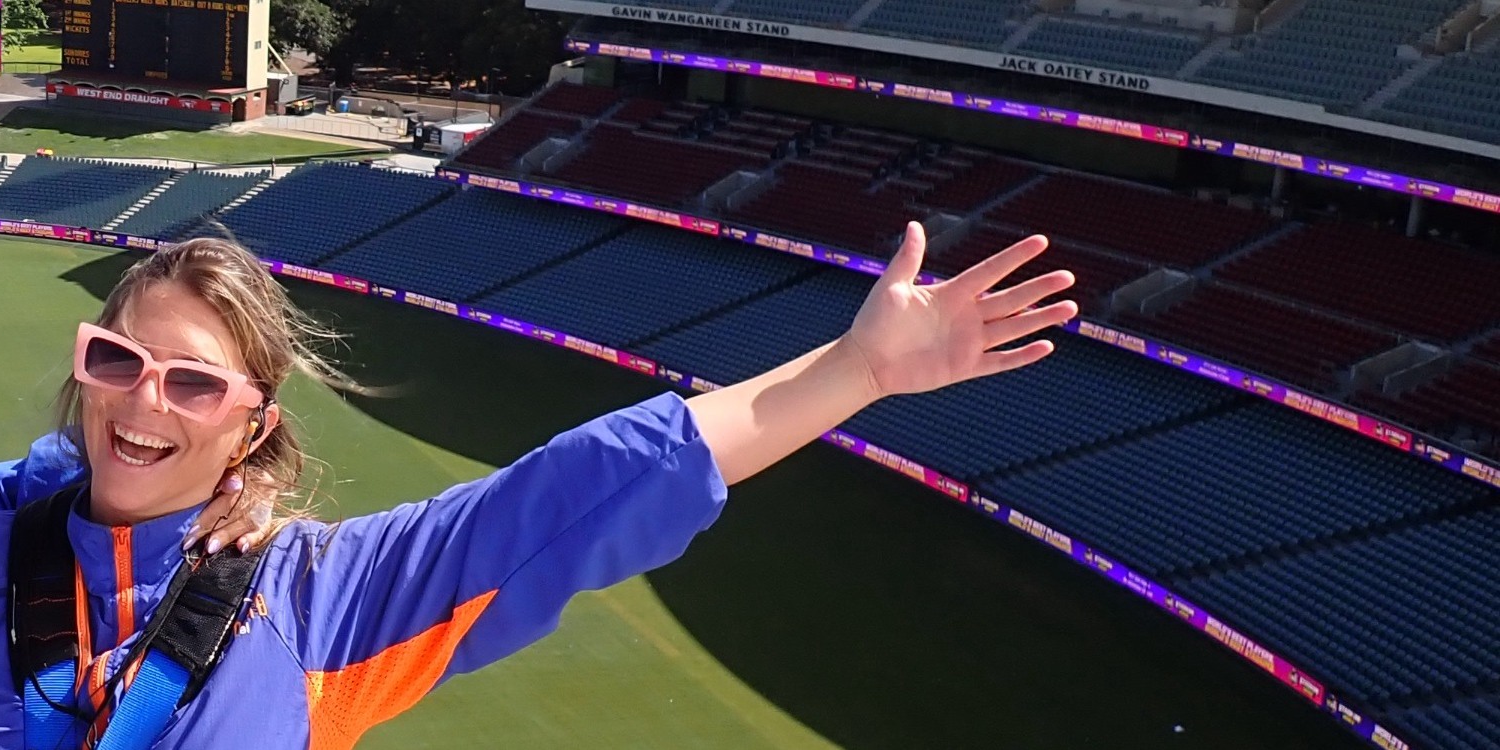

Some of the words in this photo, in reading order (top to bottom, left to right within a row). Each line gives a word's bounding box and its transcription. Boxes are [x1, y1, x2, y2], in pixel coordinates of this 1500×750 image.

[612, 6, 651, 19] GAVIN
[657, 11, 740, 30] WANGANEEN
[747, 21, 789, 36] STAND
[66, 57, 89, 66] TOTAL
[999, 57, 1036, 72] JACK
[1044, 63, 1092, 80] OATEY
[1100, 71, 1149, 90] STAND
[77, 87, 101, 98] WEST
[102, 90, 122, 100] END
[124, 91, 170, 105] DRAUGHT
